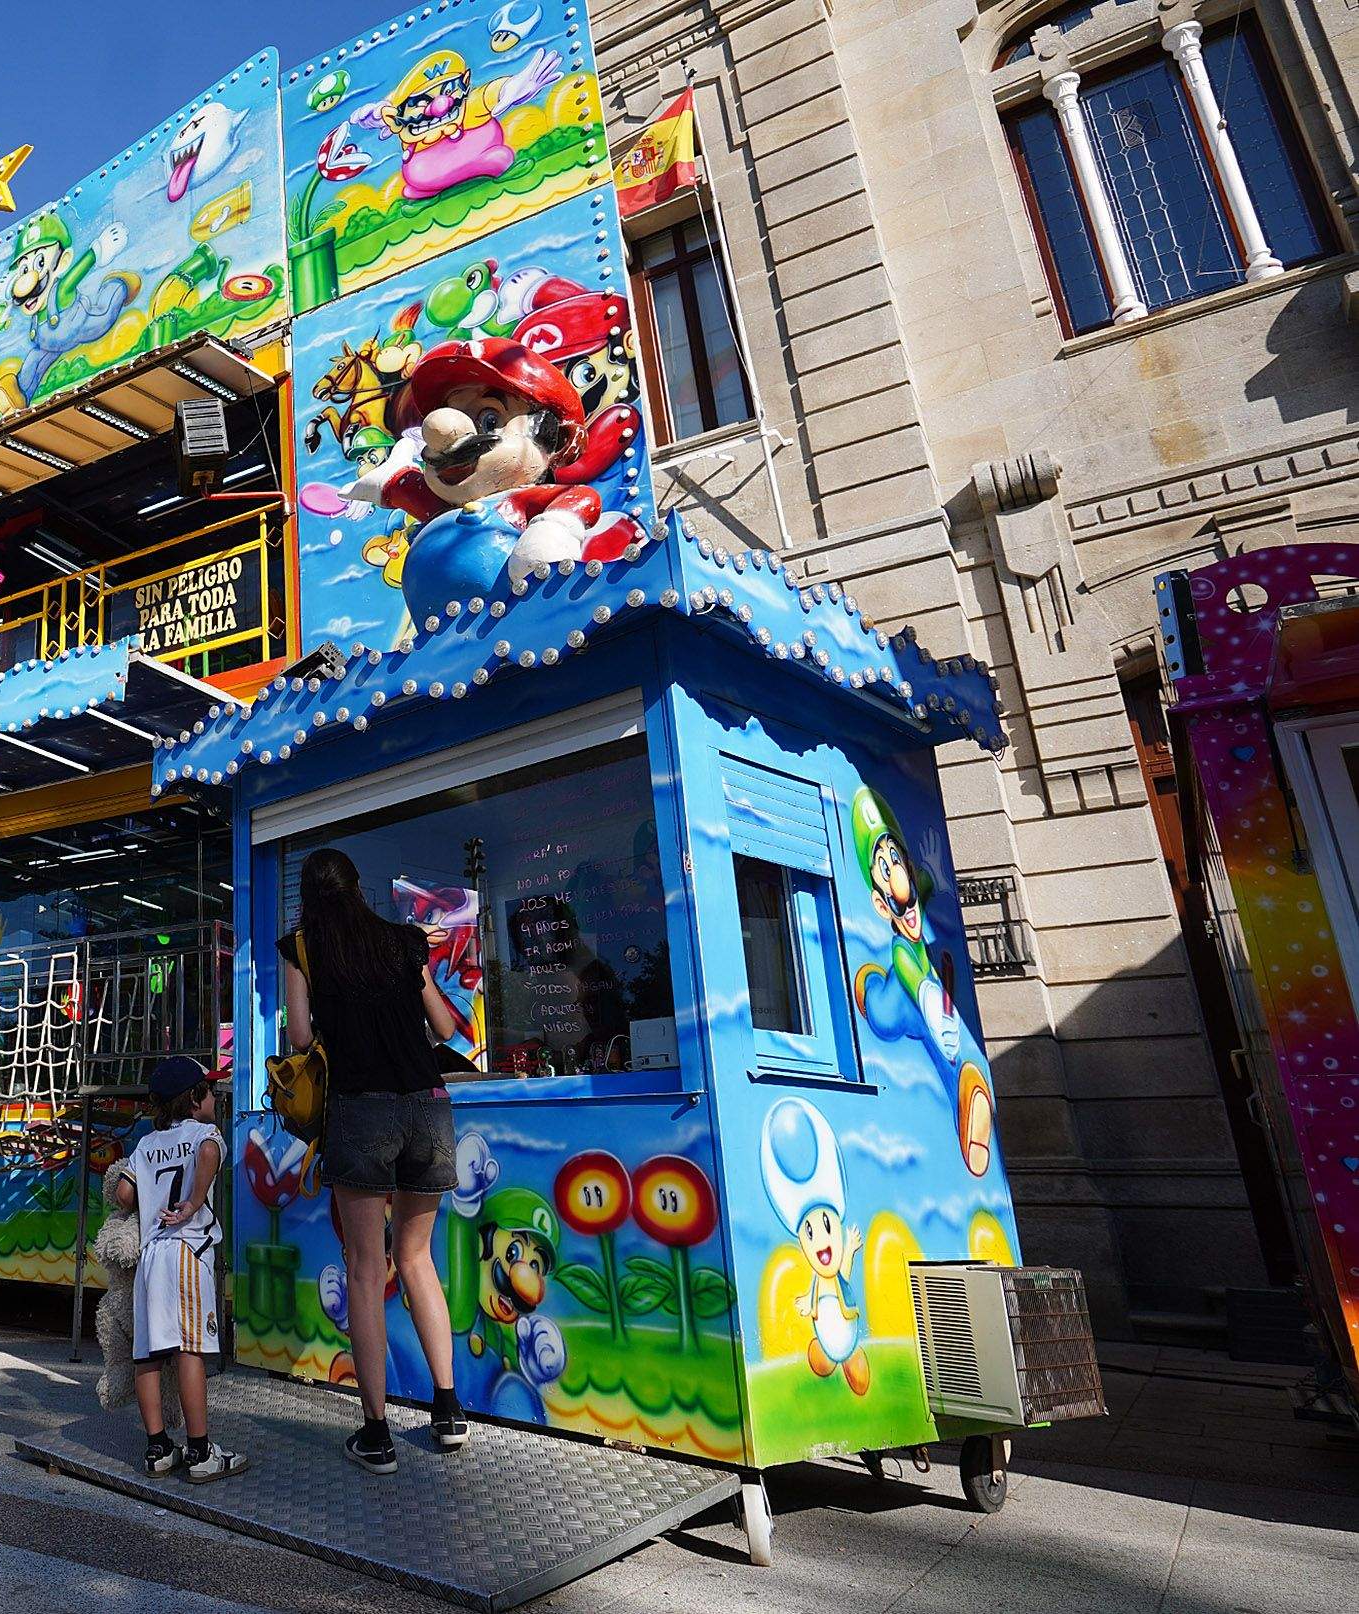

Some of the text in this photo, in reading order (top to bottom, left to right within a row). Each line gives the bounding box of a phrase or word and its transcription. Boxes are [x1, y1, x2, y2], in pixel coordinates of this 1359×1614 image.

[423, 60, 451, 80] W
[527, 327, 559, 350] M
[135, 557, 242, 609] SIN PELIGRO
[139, 583, 237, 631] PARA TODA
[140, 607, 238, 653] LA FAMILIA
[519, 895, 547, 913] LOS
[155, 1163, 184, 1230] 7
